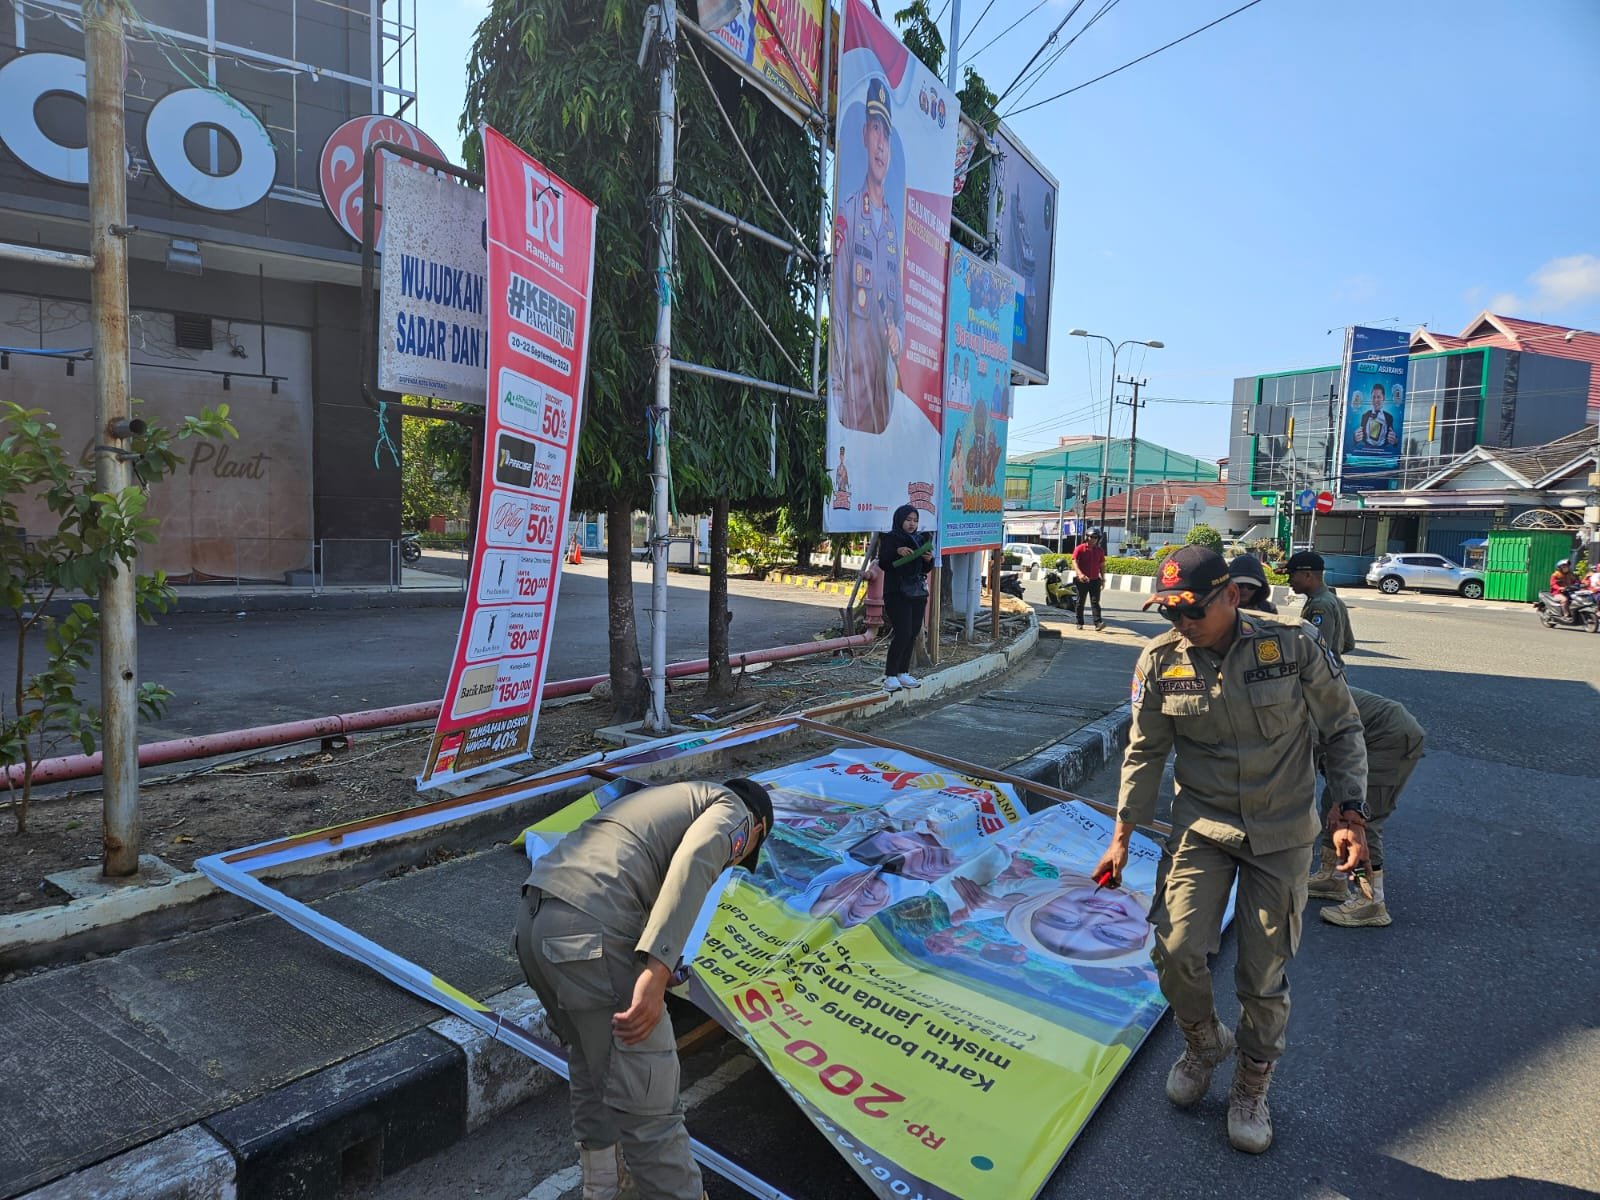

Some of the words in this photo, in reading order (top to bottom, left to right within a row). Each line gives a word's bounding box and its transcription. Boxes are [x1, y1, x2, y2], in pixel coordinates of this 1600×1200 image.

[525, 239, 564, 274] Ramayana
[401, 254, 483, 315] WUJUDKAN
[507, 275, 575, 333] #KEREN
[396, 311, 447, 362] SADAR
[452, 326, 480, 368] DAN
[511, 336, 531, 353] 20-22
[531, 345, 557, 366] September
[557, 359, 570, 373] 2024
[542, 404, 567, 438] 50%
[189, 441, 273, 480] Plant
[508, 458, 533, 472] PRECISE
[530, 502, 551, 514] DISCOUNT
[526, 513, 553, 545] 50%
[1246, 668, 1276, 683] POL
[1279, 664, 1298, 677] PP
[468, 720, 506, 740] TAMBAHAN
[491, 729, 520, 752] 40%
[692, 956, 739, 985] bagi
[852, 989, 924, 1030] janda
[819, 1001, 919, 1058] bontang
[923, 1020, 1012, 1071] miskin,
[732, 987, 907, 1120] 200-5
[920, 1048, 996, 1093] Kartu
[903, 1119, 947, 1151] Rp.
